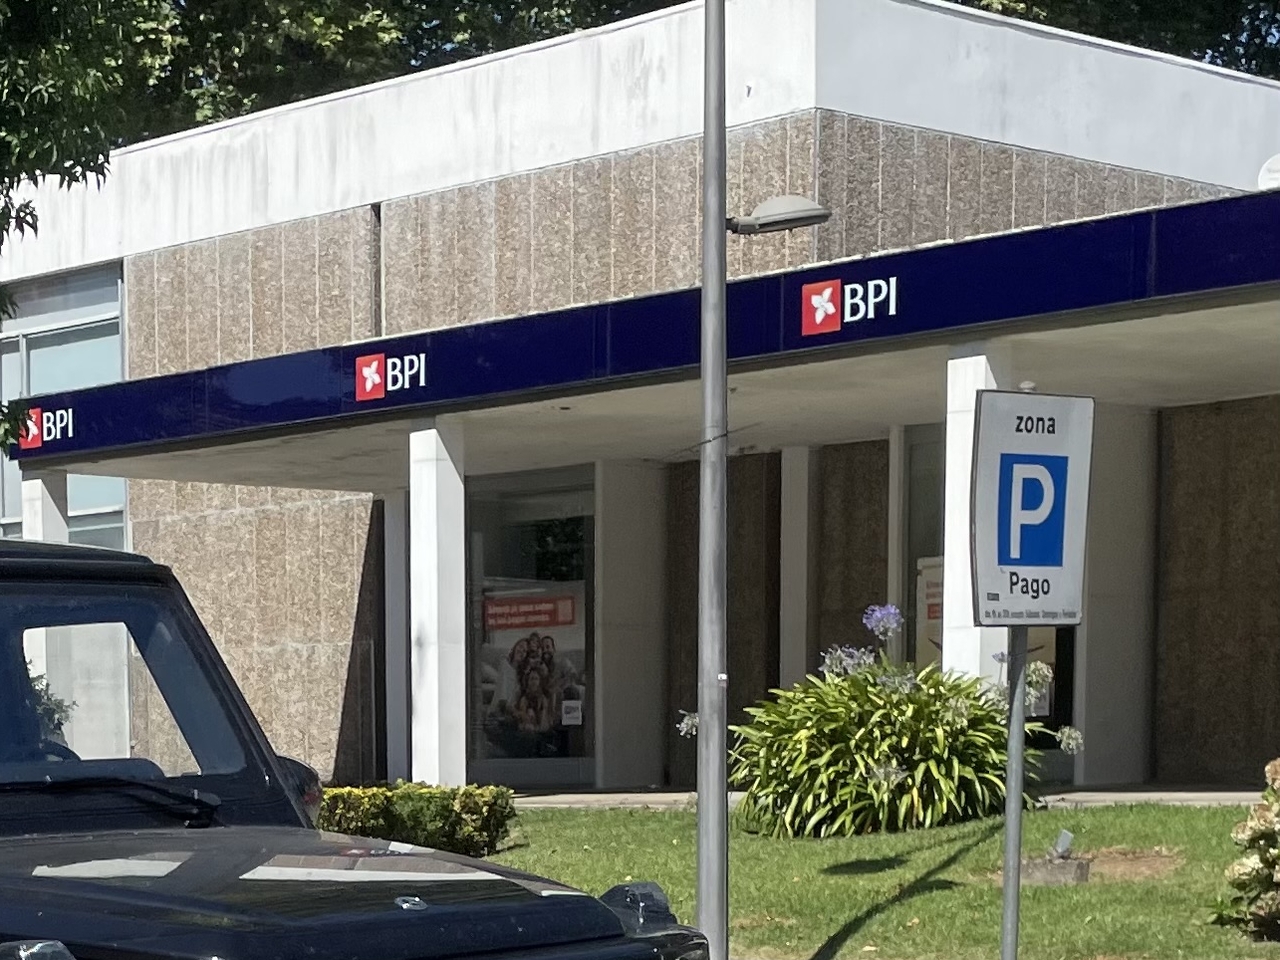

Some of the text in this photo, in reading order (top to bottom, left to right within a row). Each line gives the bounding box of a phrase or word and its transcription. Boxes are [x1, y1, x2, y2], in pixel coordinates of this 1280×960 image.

[843, 276, 897, 323] BPI
[386, 353, 426, 391] BPI
[42, 408, 73, 441] BPI
[1015, 415, 1056, 435] zona
[1009, 463, 1056, 559] P
[1009, 572, 1051, 600] Pago
